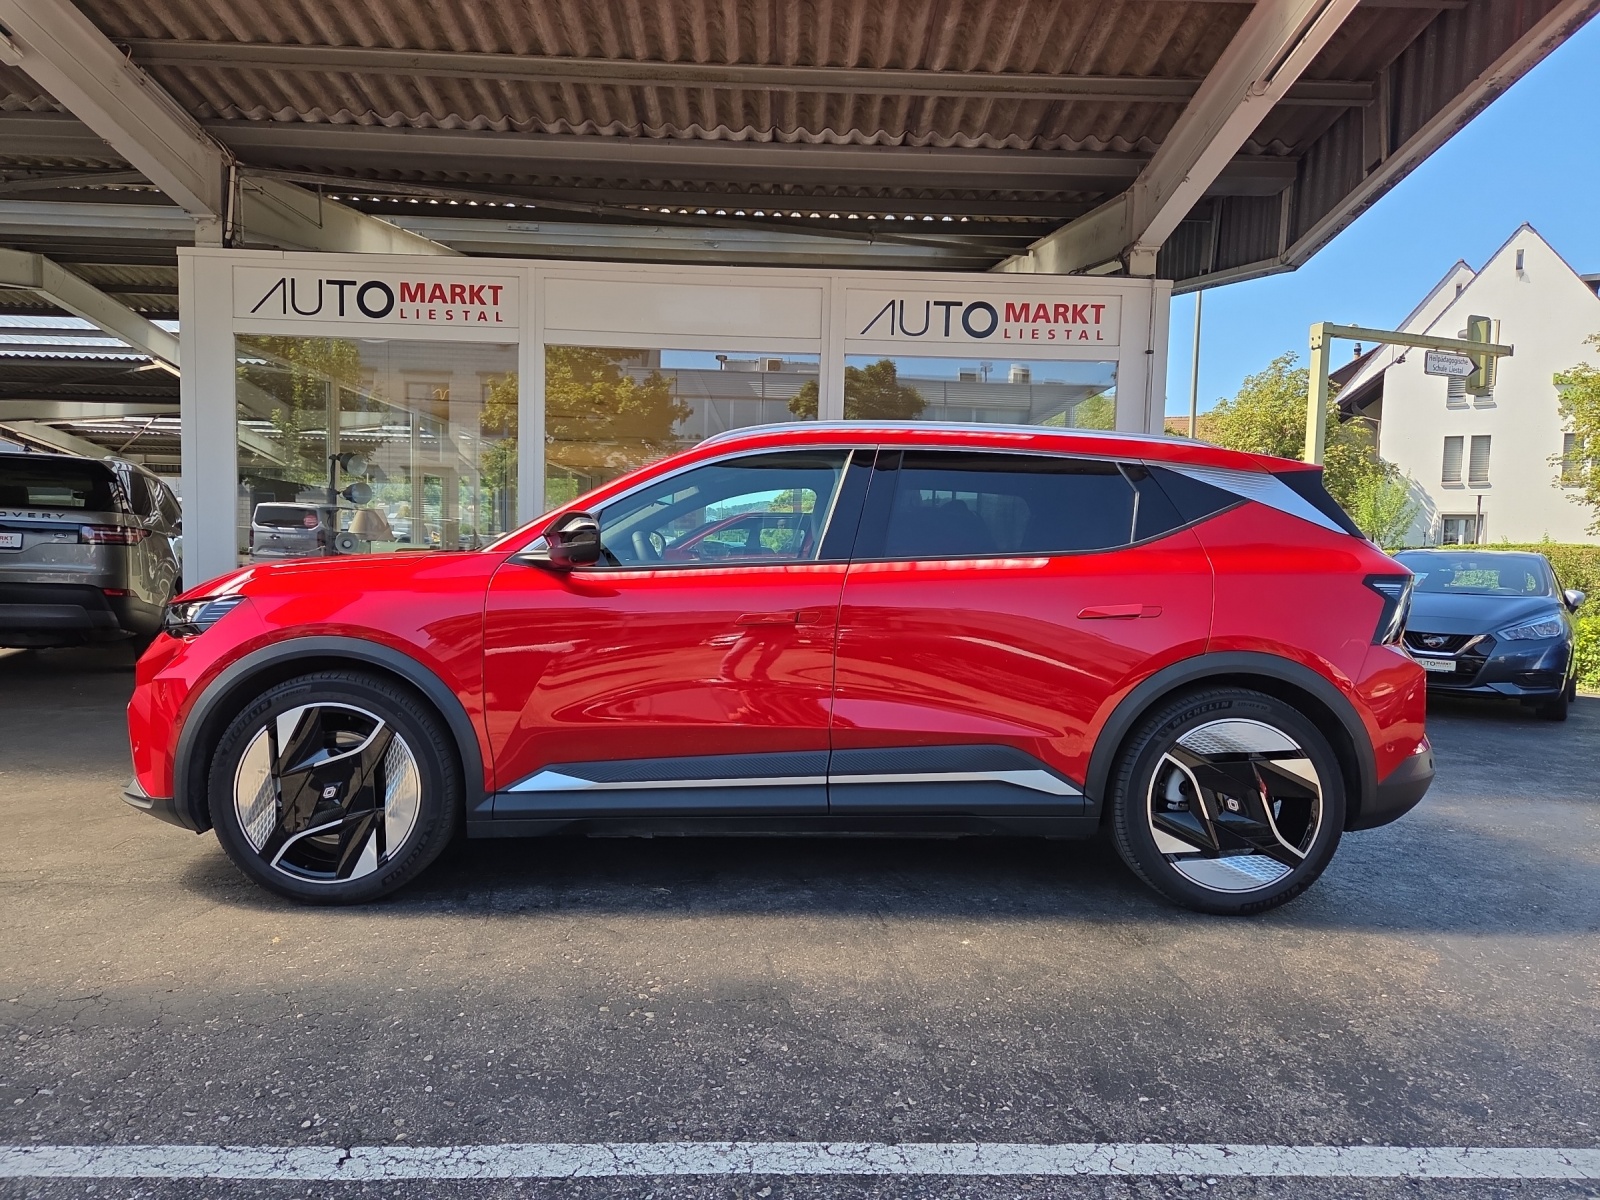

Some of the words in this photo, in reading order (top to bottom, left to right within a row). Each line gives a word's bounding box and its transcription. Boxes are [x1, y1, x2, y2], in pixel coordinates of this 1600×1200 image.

[250, 277, 395, 319] AUTO
[399, 281, 504, 306] MARKT
[399, 308, 504, 323] LIESTAL
[860, 299, 999, 339] AUTO
[1004, 302, 1106, 325] MARKT
[1003, 328, 1104, 341] LIESTAL
[1428, 354, 1469, 366] Heilpädagogische
[1432, 364, 1448, 372] Schule
[1448, 366, 1464, 374] Liestal
[1172, 701, 1230, 728] MICHELIN
